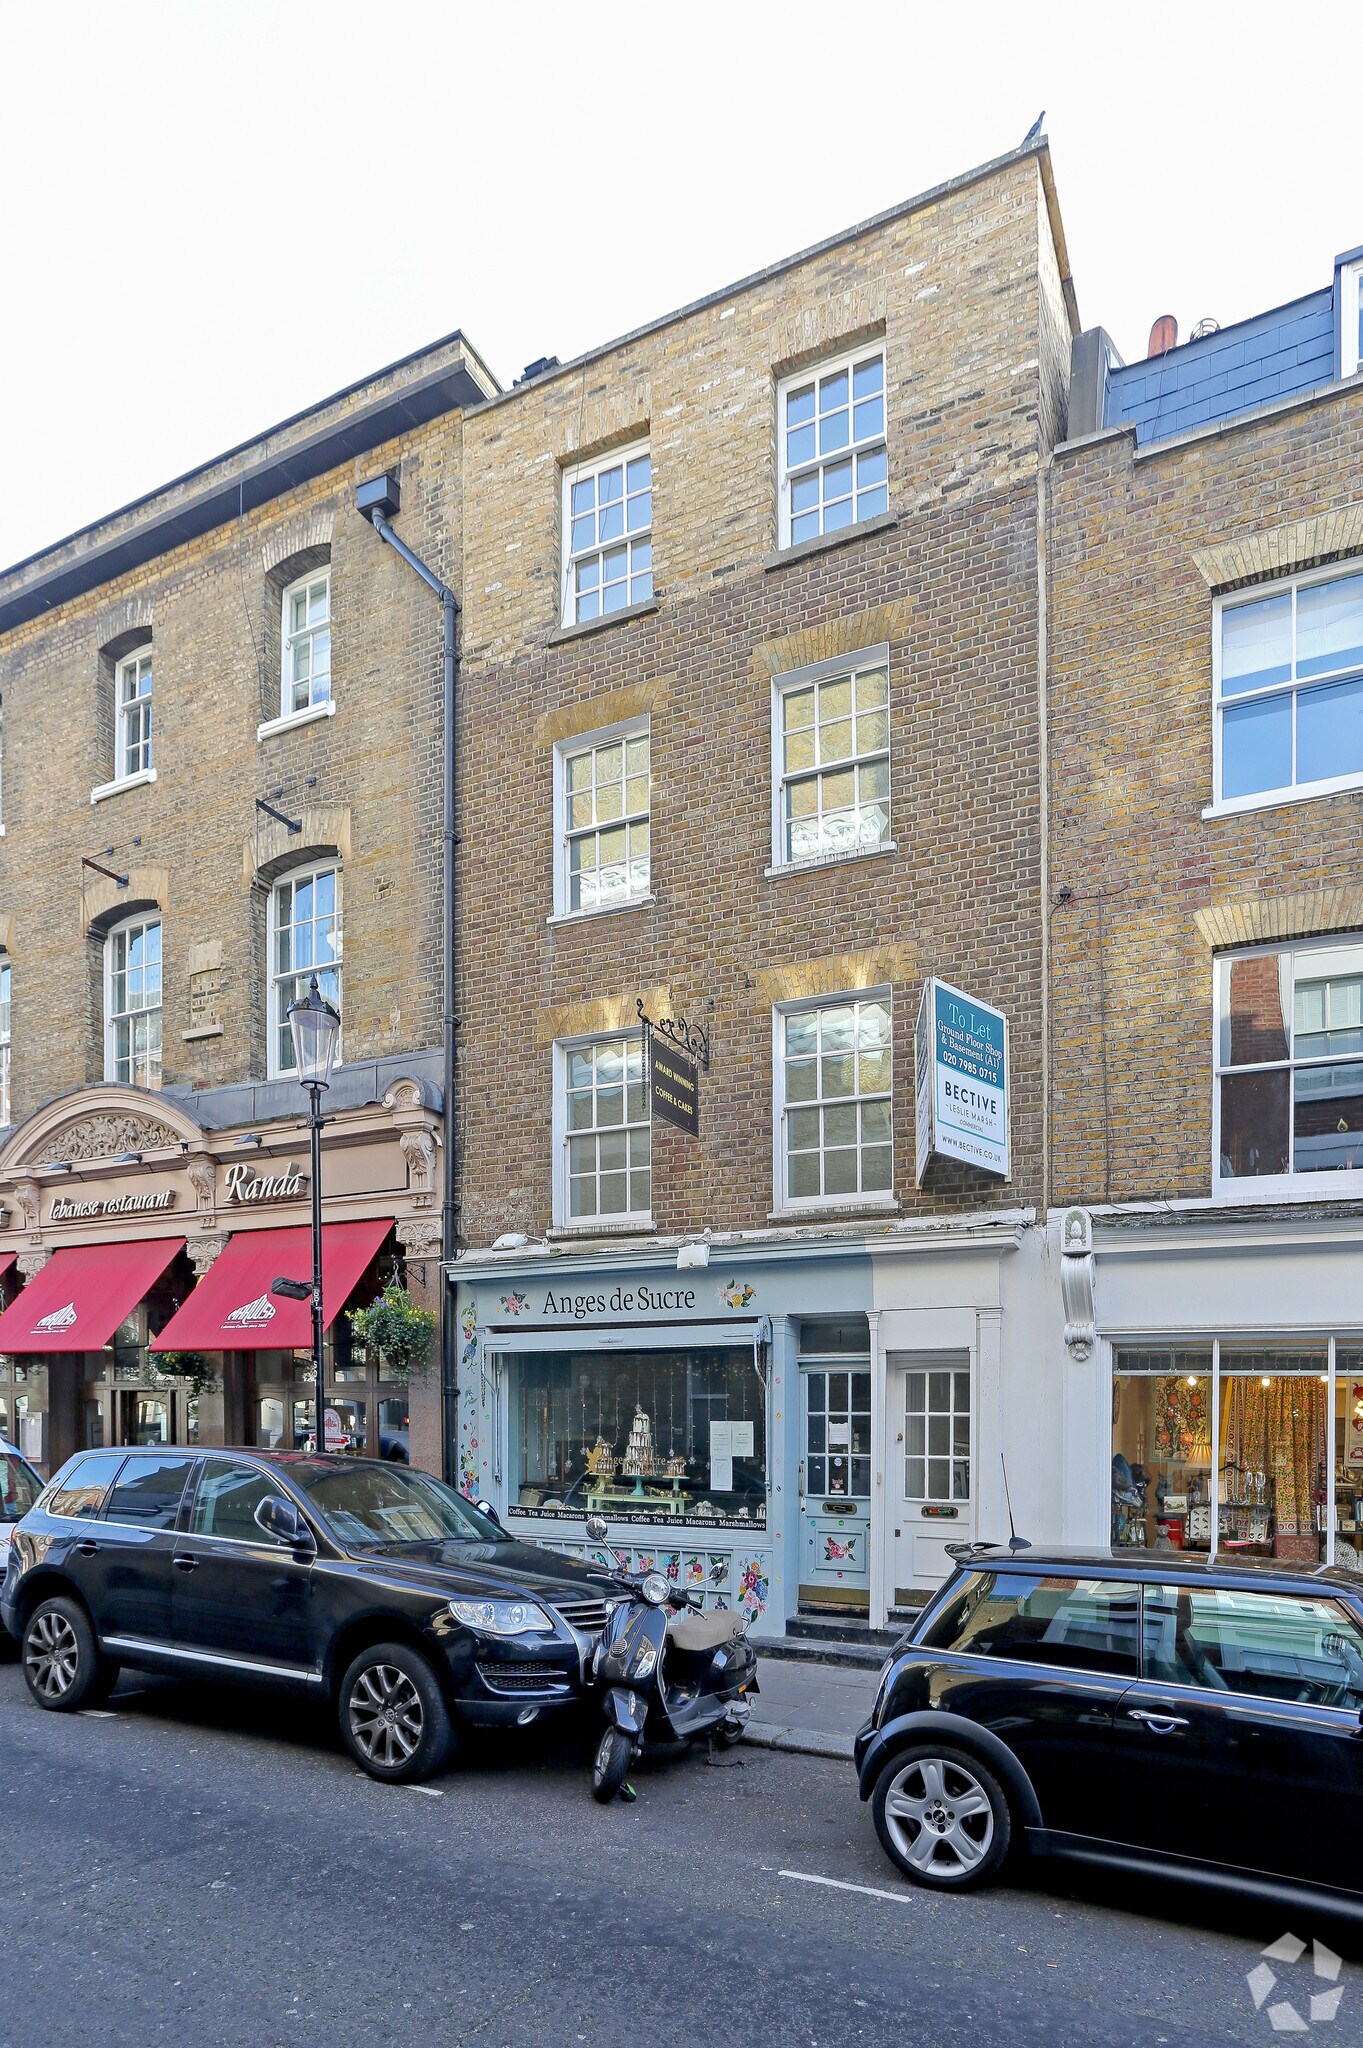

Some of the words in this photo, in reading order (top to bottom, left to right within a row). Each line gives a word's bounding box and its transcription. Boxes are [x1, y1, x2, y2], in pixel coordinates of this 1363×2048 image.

[949, 1003, 966, 1028] To
[970, 1013, 991, 1040] Let
[938, 1020, 963, 1041] Ground
[966, 1033, 984, 1050] Floor
[985, 1042, 1002, 1060] Shop
[941, 1033, 948, 1045] &
[949, 1037, 984, 1061] Basement
[985, 1054, 1000, 1070] (A1)
[655, 1060, 673, 1078] AWARD
[673, 1071, 695, 1092] WINNING
[943, 1051, 957, 1066] 020
[959, 1058, 977, 1075] 7985
[979, 1067, 997, 1083] 0715
[655, 1085, 673, 1103] COFFEE
[678, 1099, 693, 1115] CAKES
[945, 1081, 997, 1115] BECTIVE
[960, 1119, 984, 1133] COMMERCIAL
[942, 1134, 1002, 1163] WWW.BECTIVE.CO.UK
[223, 1162, 304, 1202] Randa
[48, 1199, 99, 1220] lebanese
[101, 1191, 172, 1214] restaurant
[542, 1290, 606, 1319] Anges
[609, 1287, 634, 1311] de
[637, 1286, 696, 1311] Sucre
[540, 1510, 555, 1518] Juice
[557, 1511, 585, 1520] Macarons
[587, 1514, 629, 1522] Marshmallows
[631, 1515, 650, 1523] Coffee
[686, 1518, 716, 1526] Macarons
[719, 1520, 766, 1529] Marshmallows
